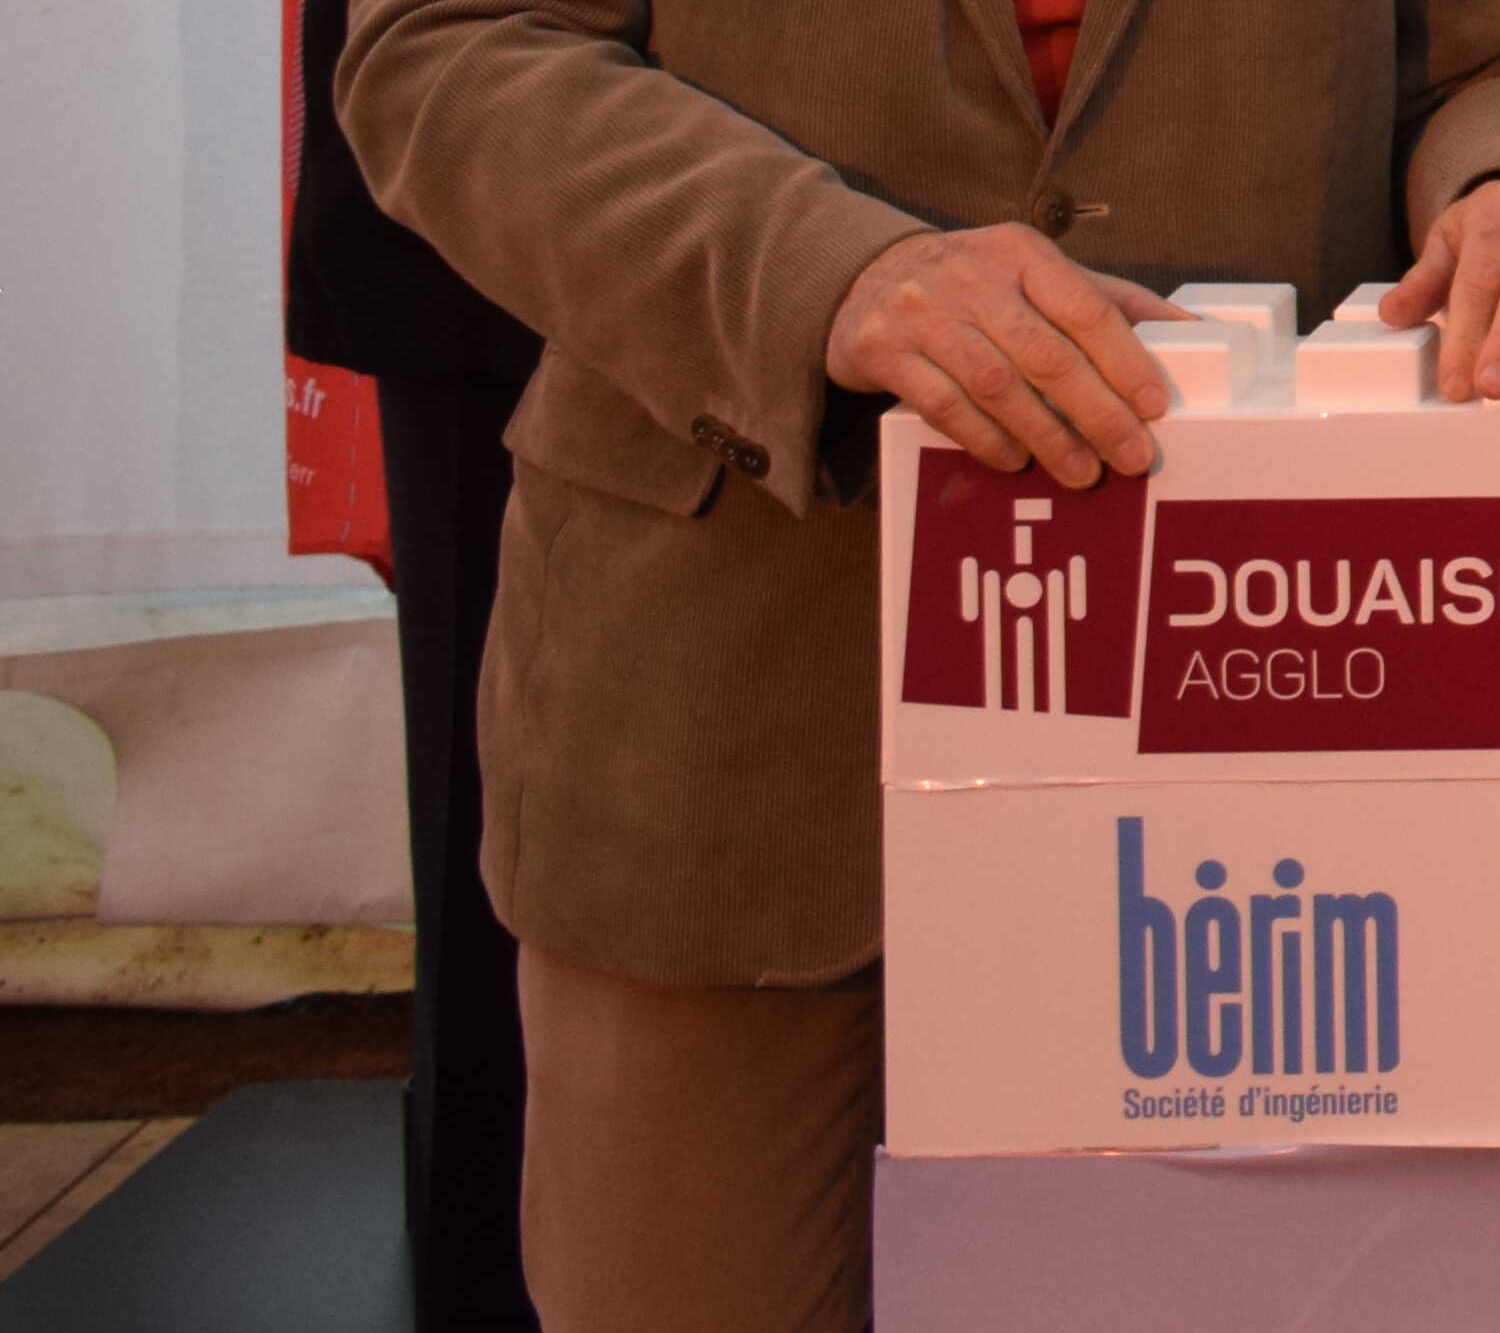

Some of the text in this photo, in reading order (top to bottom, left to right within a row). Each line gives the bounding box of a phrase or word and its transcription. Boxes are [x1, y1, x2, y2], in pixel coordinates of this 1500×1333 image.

[1175, 646, 1386, 703] AGGLO
[1123, 1085, 1399, 1124] Société d'ingénierie
